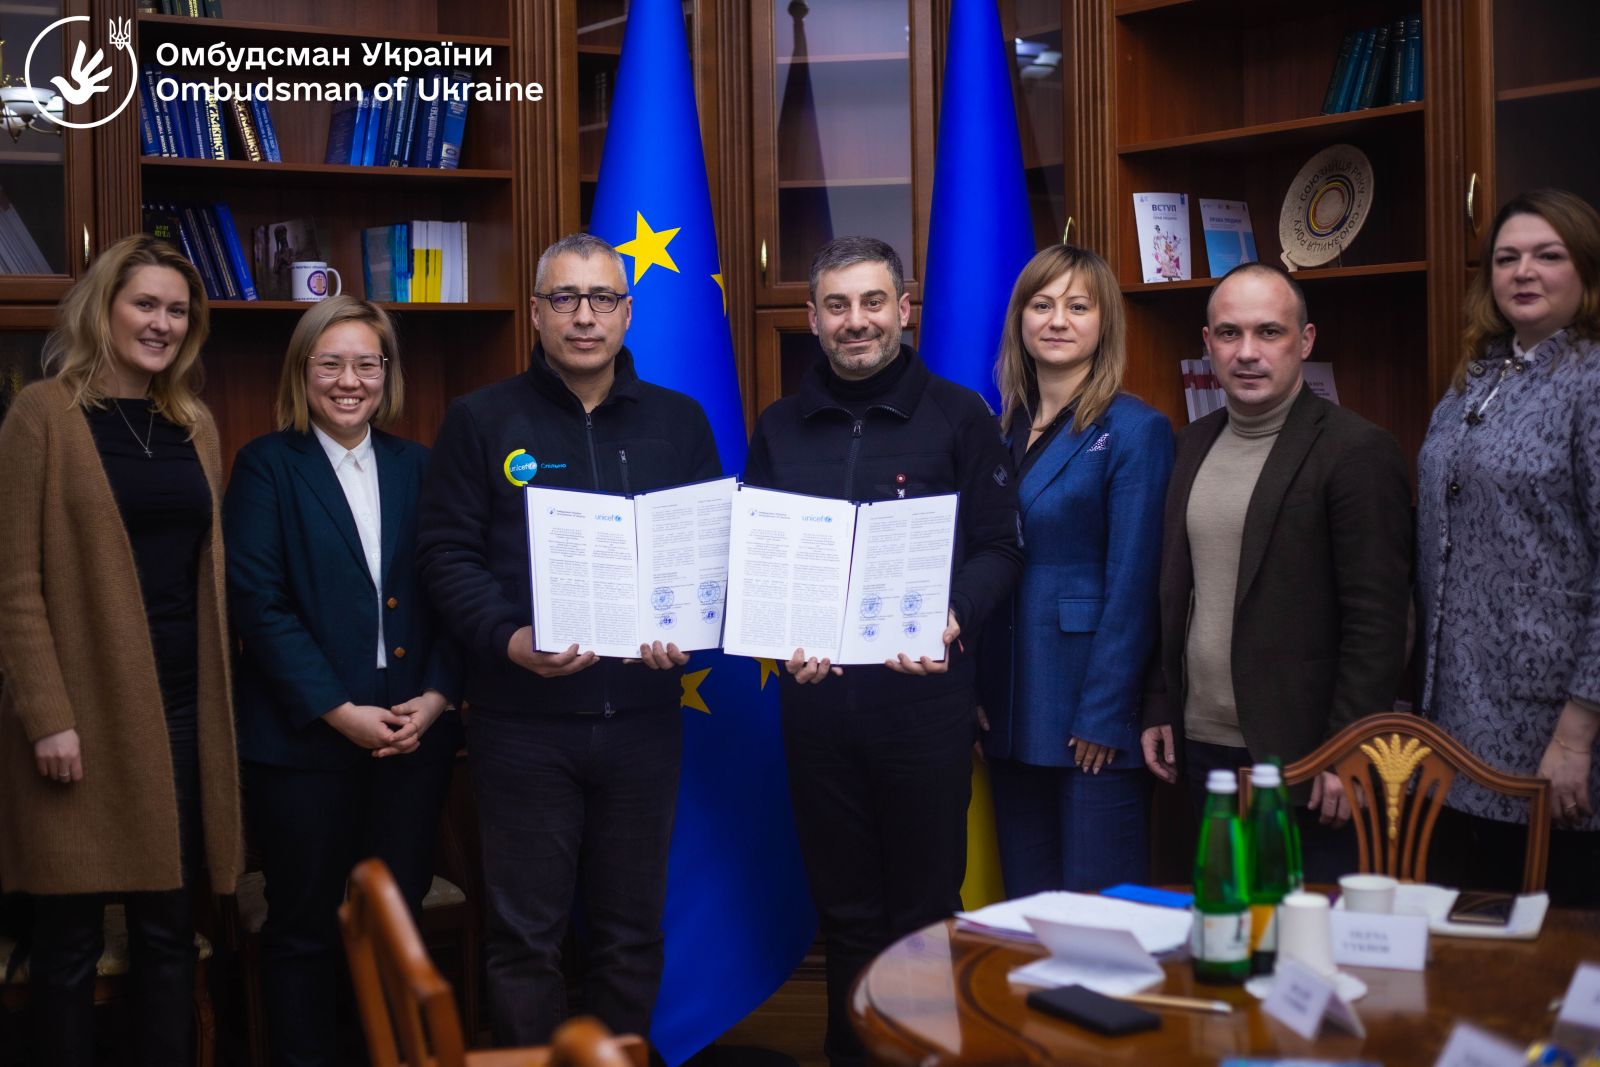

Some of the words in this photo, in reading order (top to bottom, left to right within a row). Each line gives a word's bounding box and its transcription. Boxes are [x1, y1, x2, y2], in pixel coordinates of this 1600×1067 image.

[1151, 204, 1177, 212] ВСТУП
[510, 462, 530, 472] unicef
[594, 513, 614, 522] unicef
[801, 515, 824, 523] unicef
